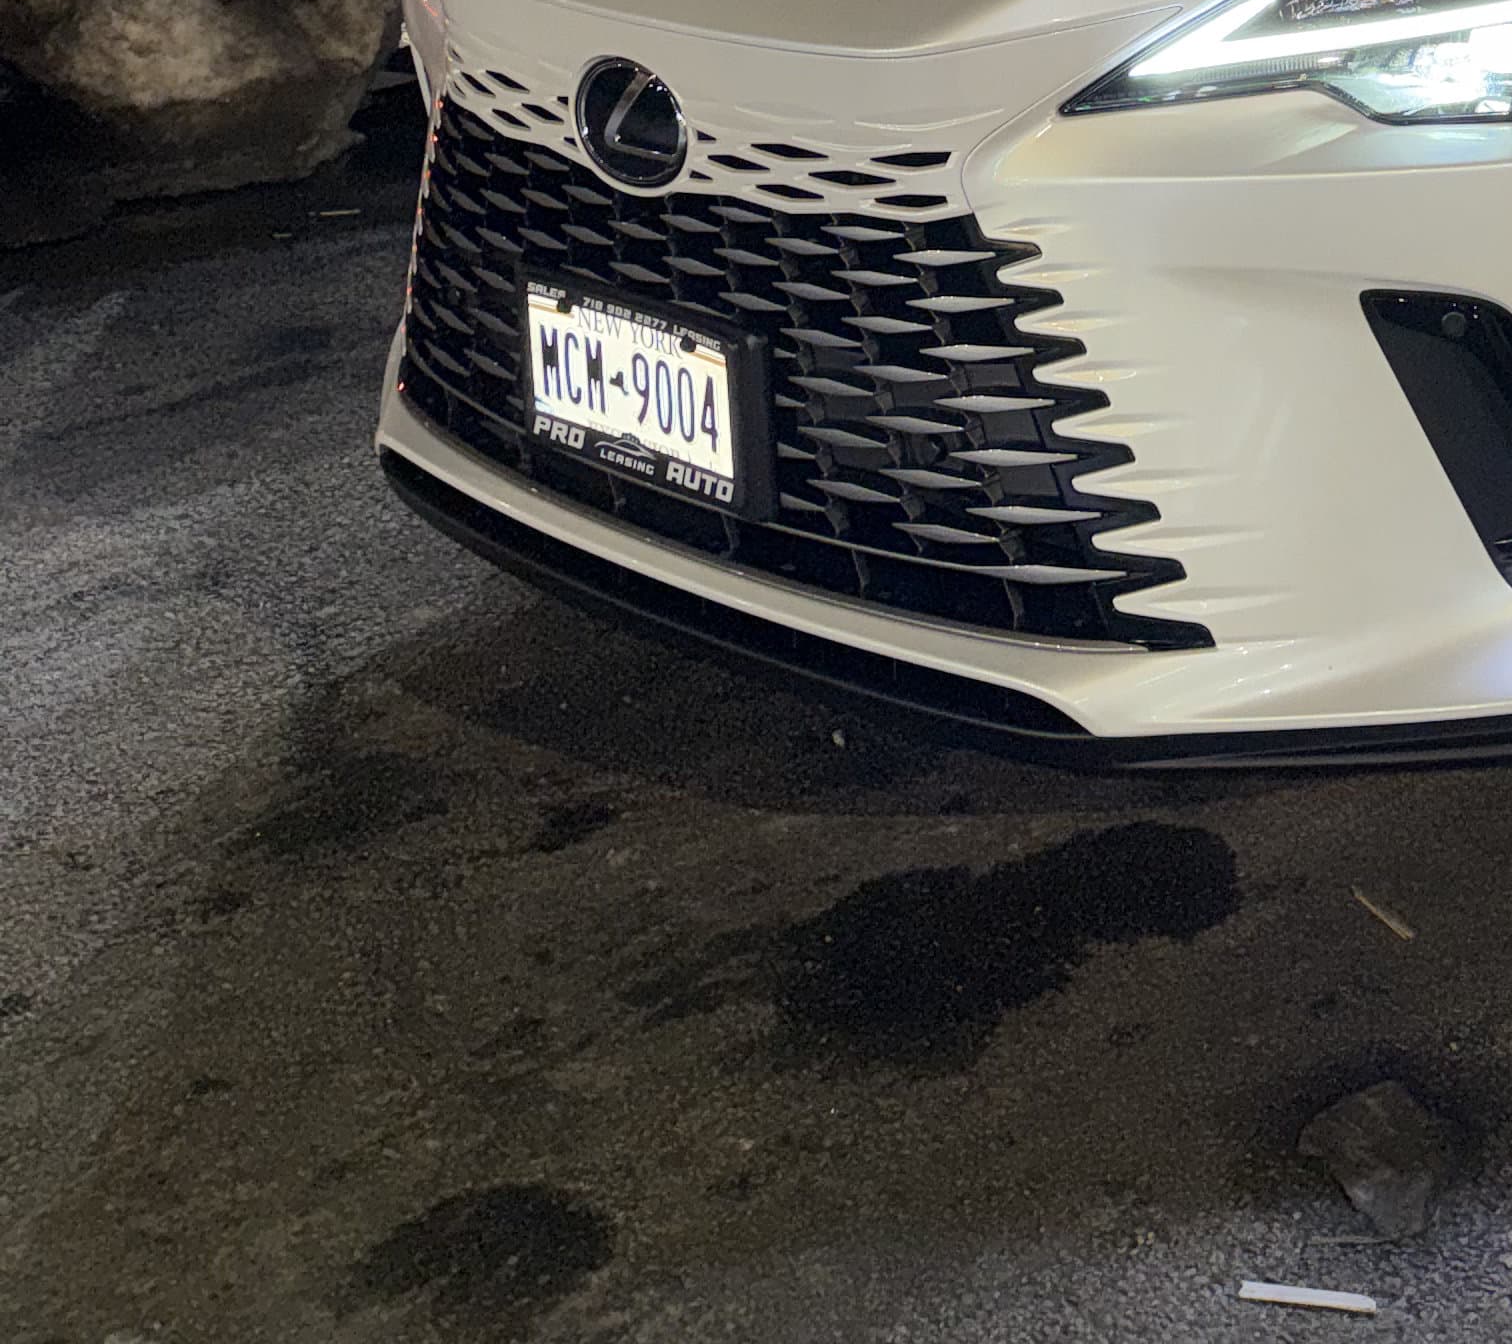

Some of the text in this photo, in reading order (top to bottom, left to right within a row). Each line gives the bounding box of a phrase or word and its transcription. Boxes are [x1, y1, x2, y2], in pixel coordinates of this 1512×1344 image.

[582, 295, 603, 312] 718
[606, 303, 632, 320] 902
[577, 306, 685, 360] NEW YORK
[533, 415, 587, 450] PRO
[666, 461, 735, 504] AUTO
[599, 447, 656, 477] LEASING
